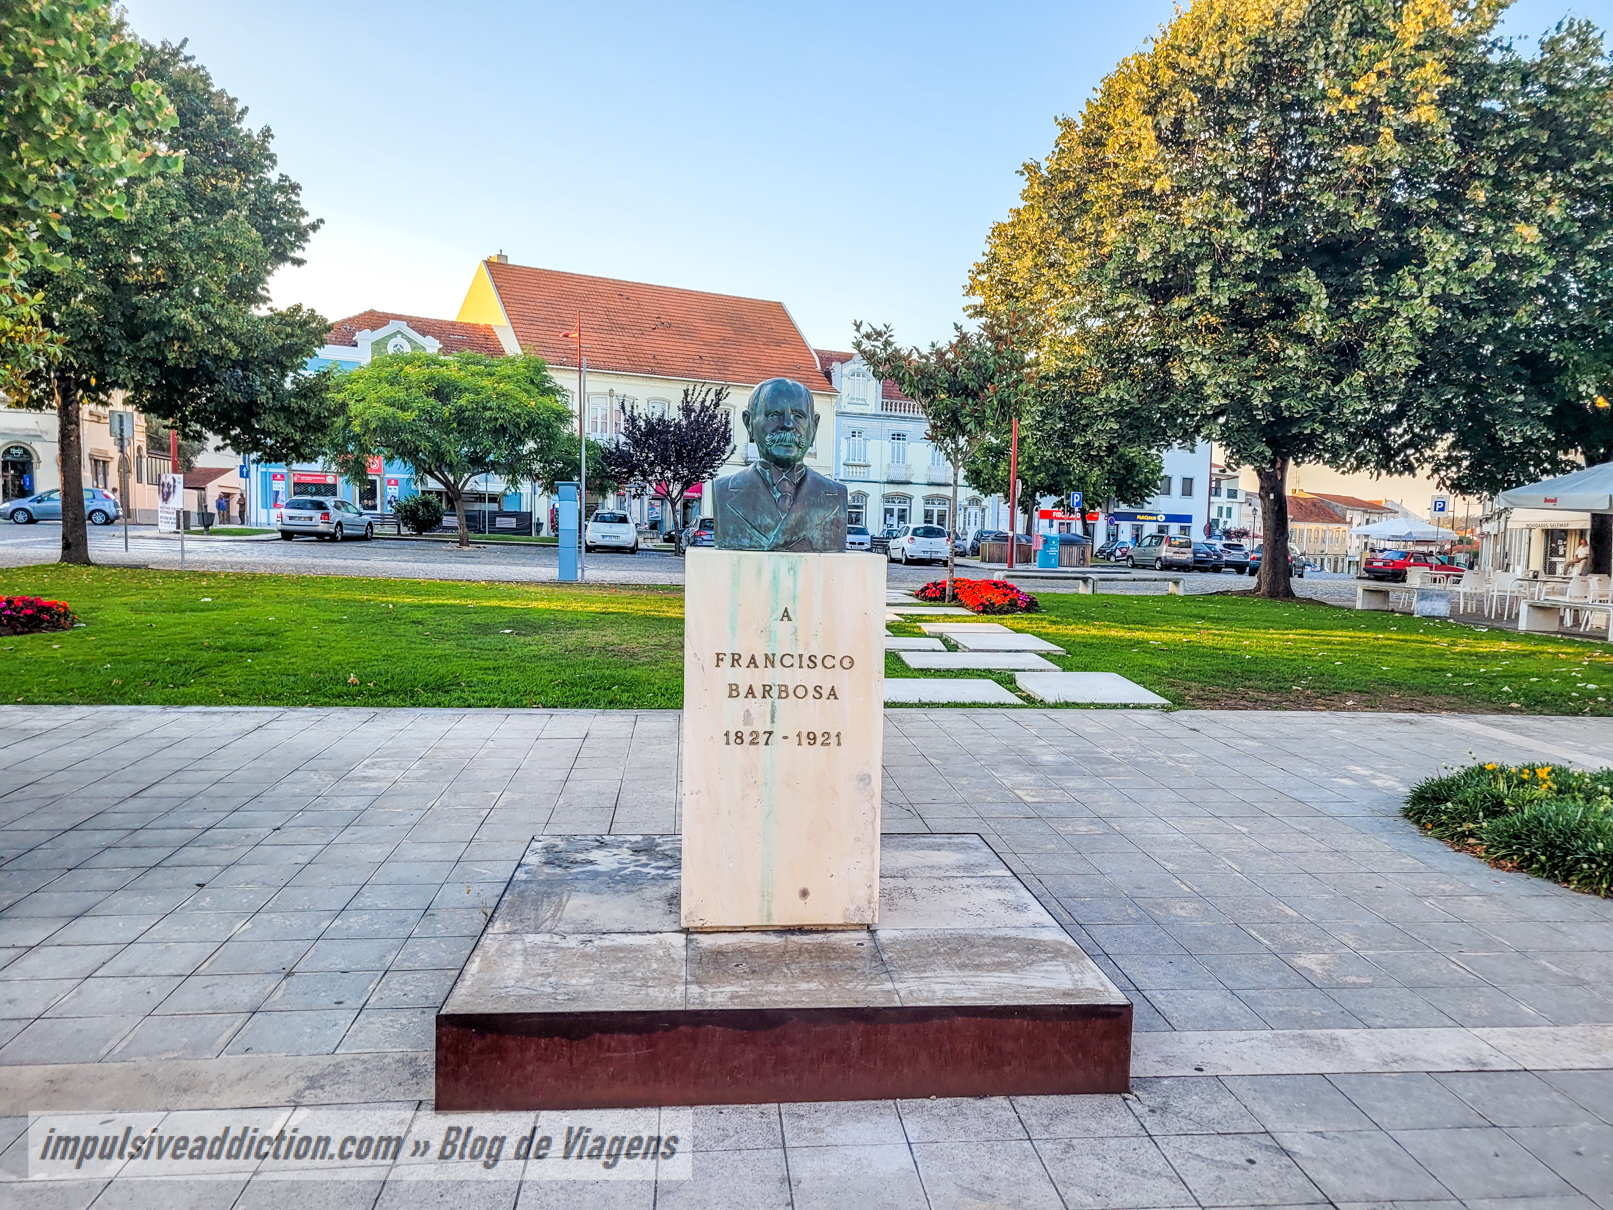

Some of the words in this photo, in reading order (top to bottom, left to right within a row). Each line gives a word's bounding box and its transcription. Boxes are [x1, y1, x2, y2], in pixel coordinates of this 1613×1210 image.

[1073, 493, 1080, 506] P
[1435, 501, 1444, 511] P
[779, 606, 793, 622] A
[714, 652, 855, 670] FRANCISCO
[727, 683, 839, 700] BARBOSA
